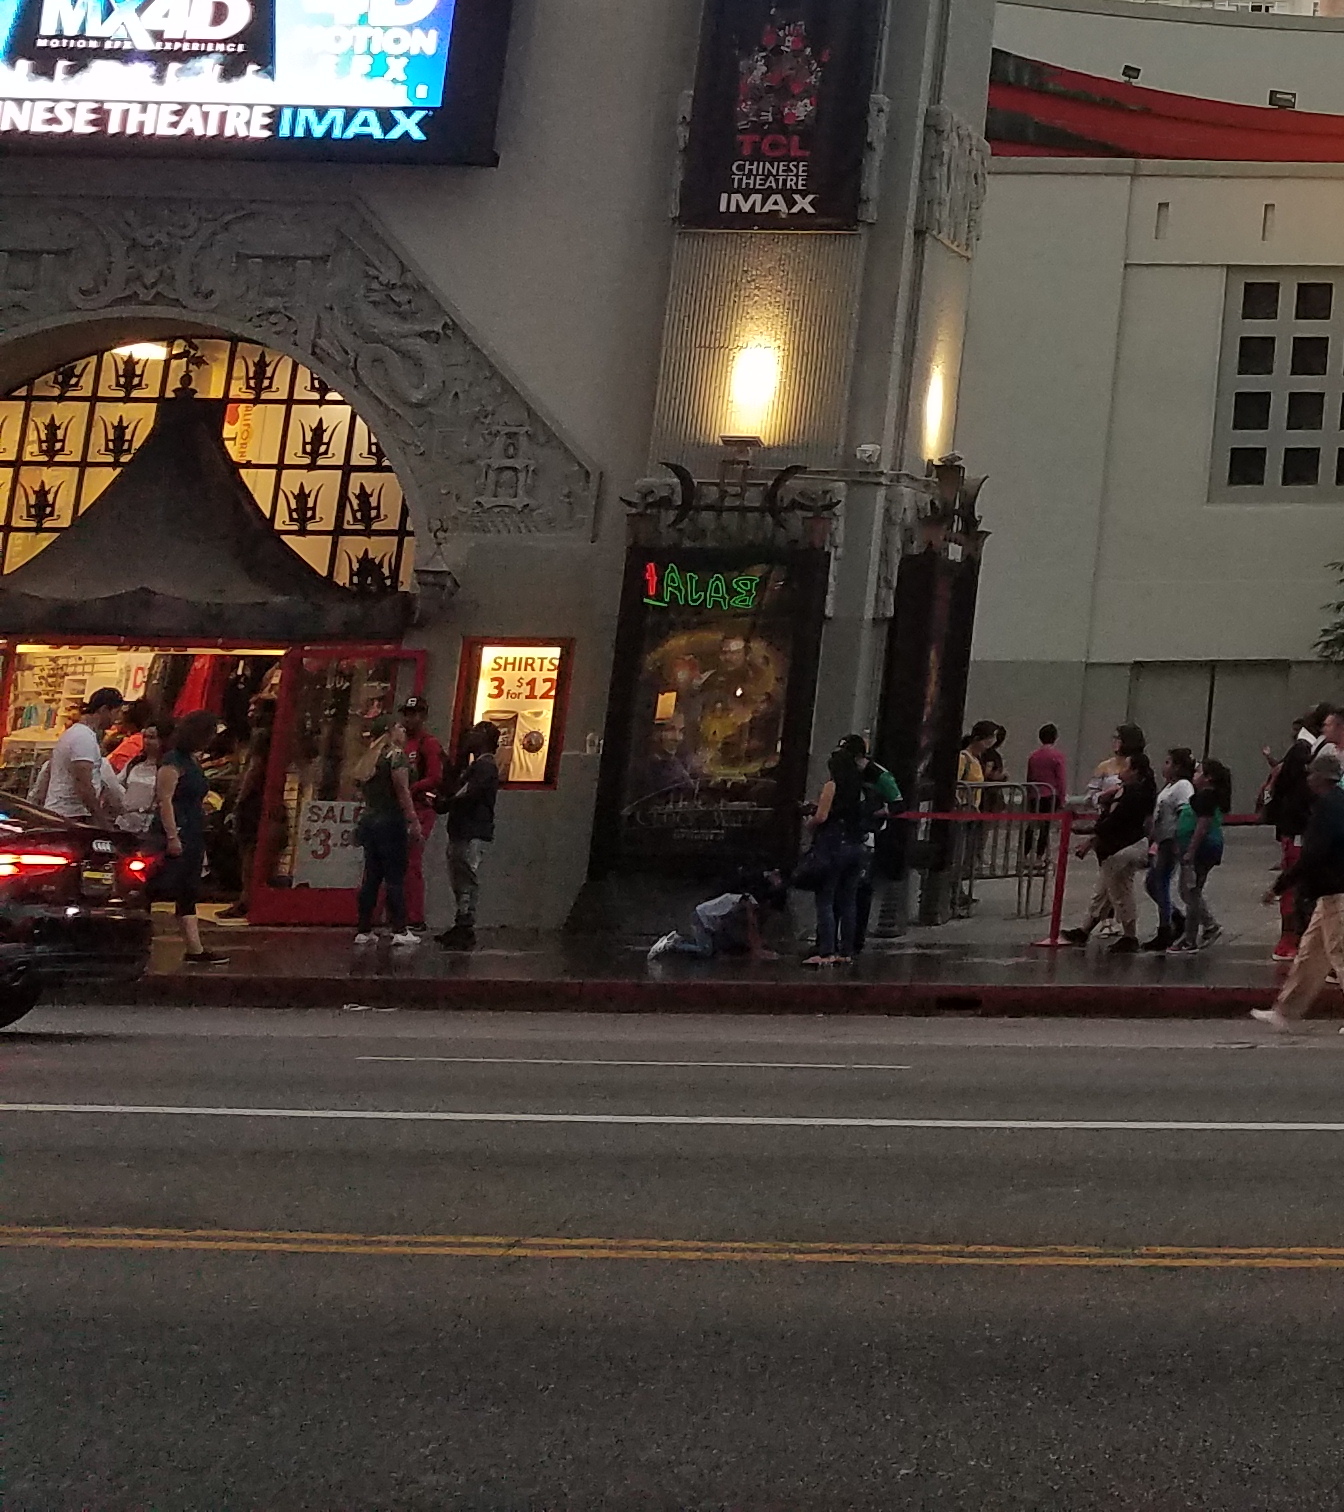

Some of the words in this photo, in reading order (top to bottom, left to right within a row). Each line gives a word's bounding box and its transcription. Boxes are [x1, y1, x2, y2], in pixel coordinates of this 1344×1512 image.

[36, 38, 100, 48] MOTION
[155, 41, 248, 52] EXPERIENCE
[103, 102, 275, 139] THEATRE
[279, 107, 429, 140] IMAX
[736, 134, 812, 157] TCL
[731, 160, 809, 176] CHINESE
[731, 175, 808, 190] THEATRE
[719, 192, 819, 214] IMAX
[491, 656, 560, 672] SHIRTS
[487, 676, 505, 700] 3
[506, 689, 522, 700] for
